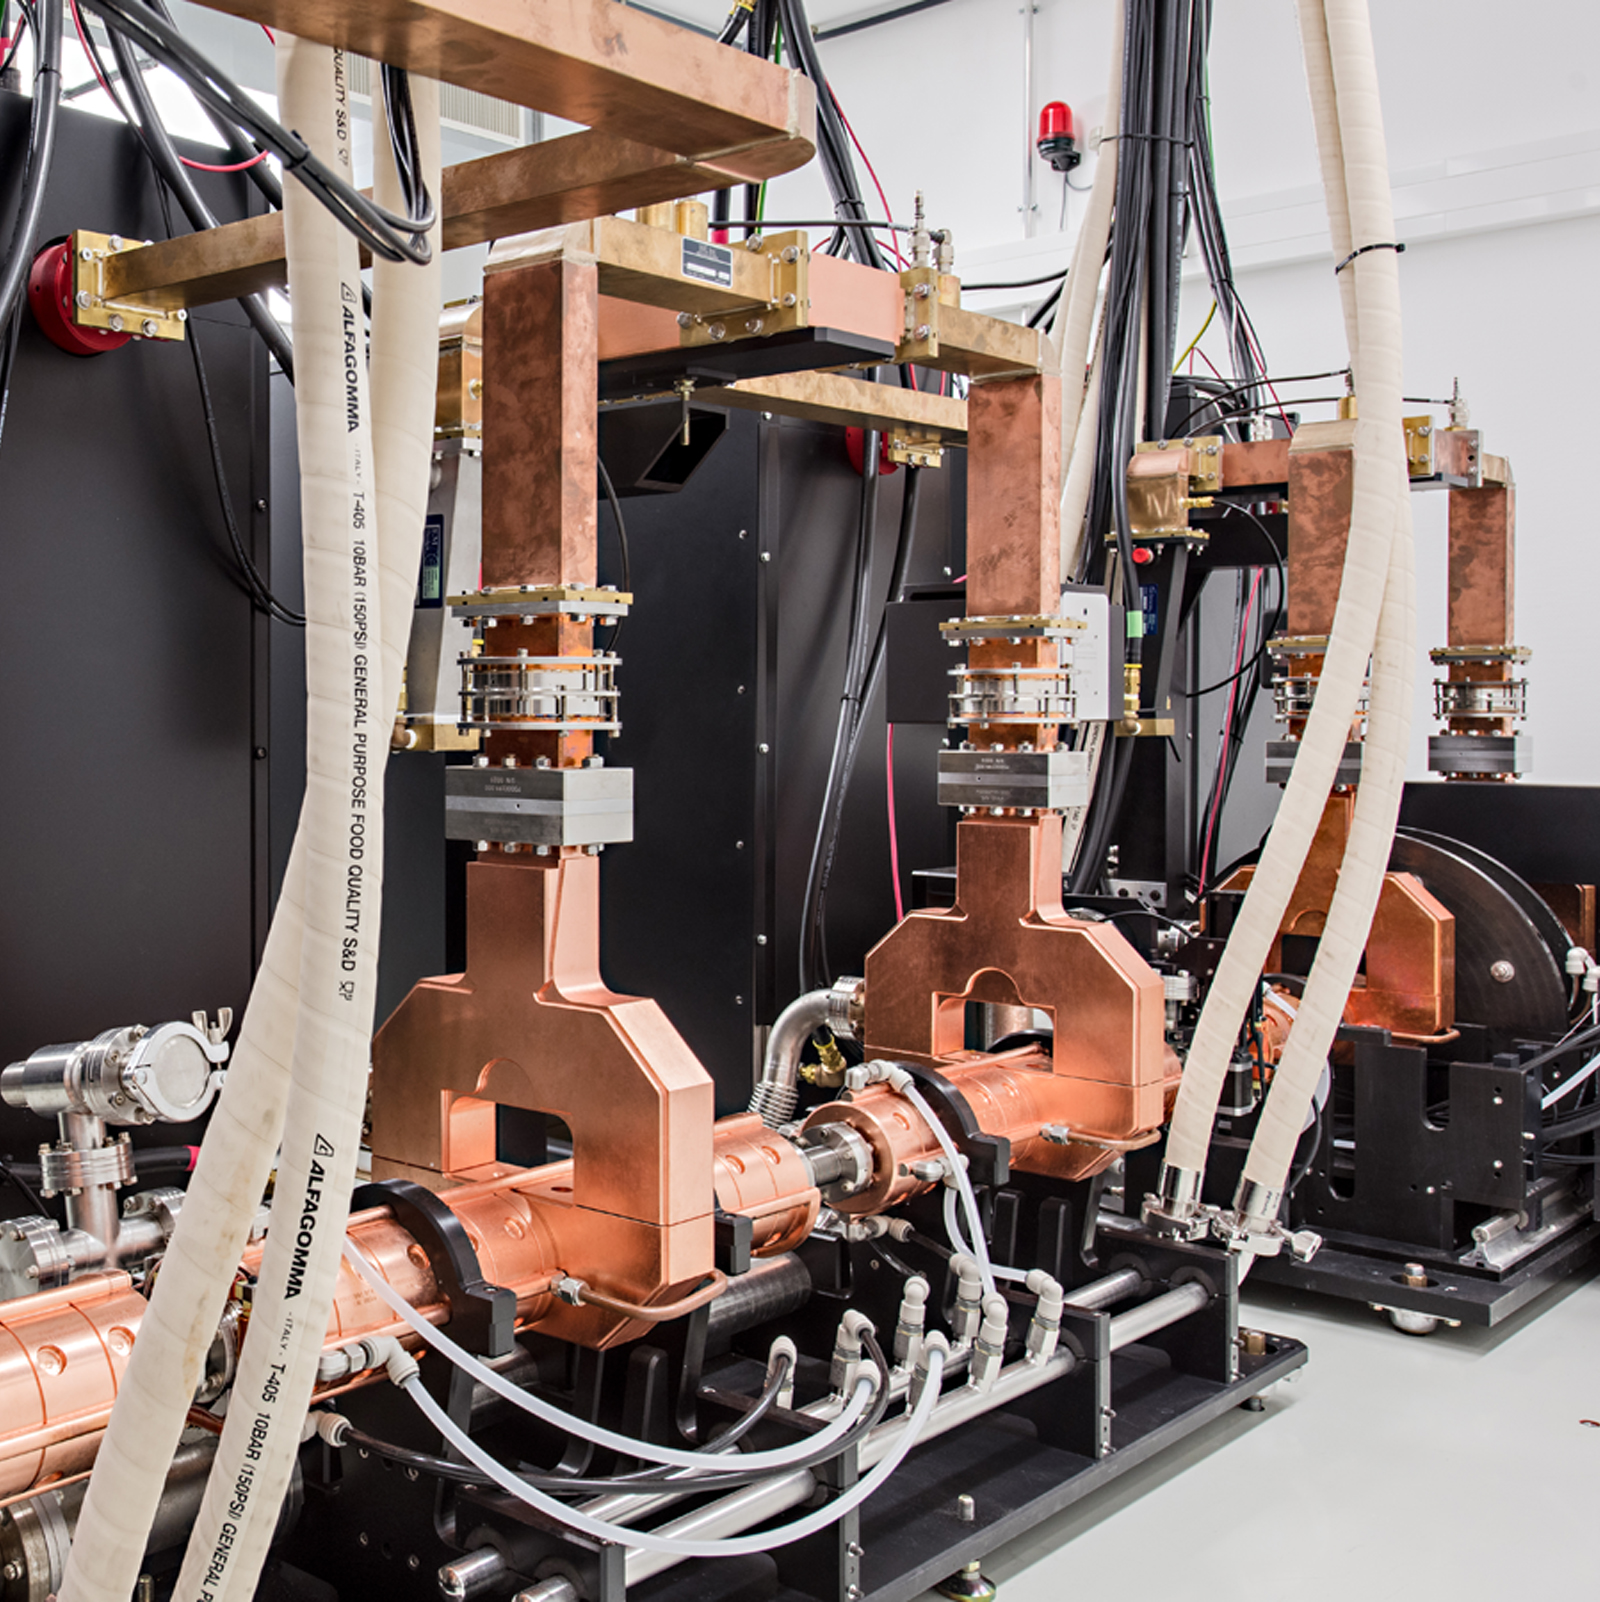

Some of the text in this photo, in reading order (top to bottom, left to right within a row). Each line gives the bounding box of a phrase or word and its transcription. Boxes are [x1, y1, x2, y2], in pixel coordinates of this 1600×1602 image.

[335, 109, 348, 141] S&D
[342, 305, 360, 433] ALFAGOMMA
[354, 449, 362, 478] ITALY
[353, 491, 366, 530] T-405
[353, 539, 367, 588] 10BAR
[353, 591, 368, 650] (150PSI)
[353, 654, 368, 729] GENERAL
[351, 732, 367, 809] PURPOSE
[349, 813, 366, 860] FOOD
[345, 864, 363, 933] QUALITY
[341, 937, 358, 972] S&D
[284, 1159, 325, 1300] ALFAGOMMA
[280, 1318, 293, 1350] ITALY
[261, 1363, 286, 1404] T-405
[245, 1412, 271, 1460] 10BAR
[228, 1463, 257, 1520] (150PSI)
[203, 1522, 238, 1587] GENERAL
